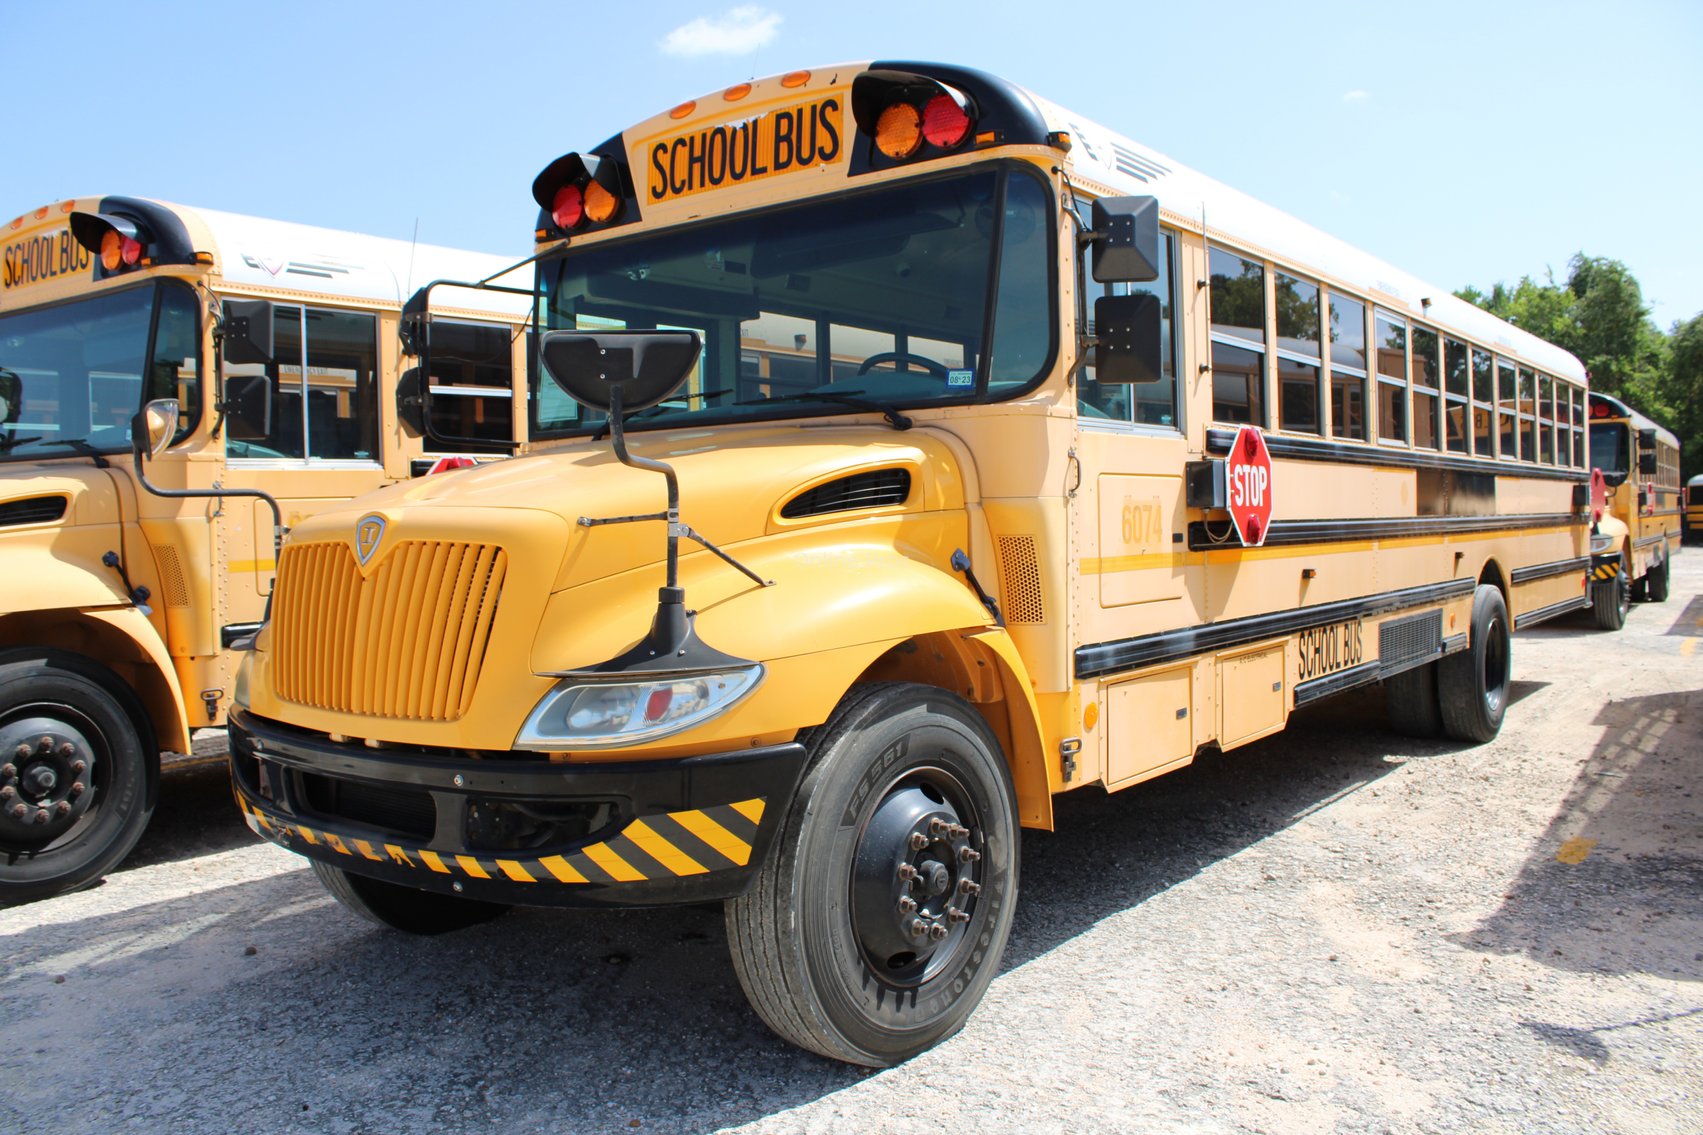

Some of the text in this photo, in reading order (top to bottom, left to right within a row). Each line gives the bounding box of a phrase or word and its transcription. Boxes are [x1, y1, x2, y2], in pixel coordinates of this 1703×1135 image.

[651, 98, 839, 200] SCHOOL BUS
[4, 235, 57, 288] SCHOOL
[1234, 463, 1268, 507] STOP
[1122, 504, 1163, 544] 6074
[1298, 619, 1363, 681] SCHOOL BUS
[849, 740, 903, 820] FS 561
